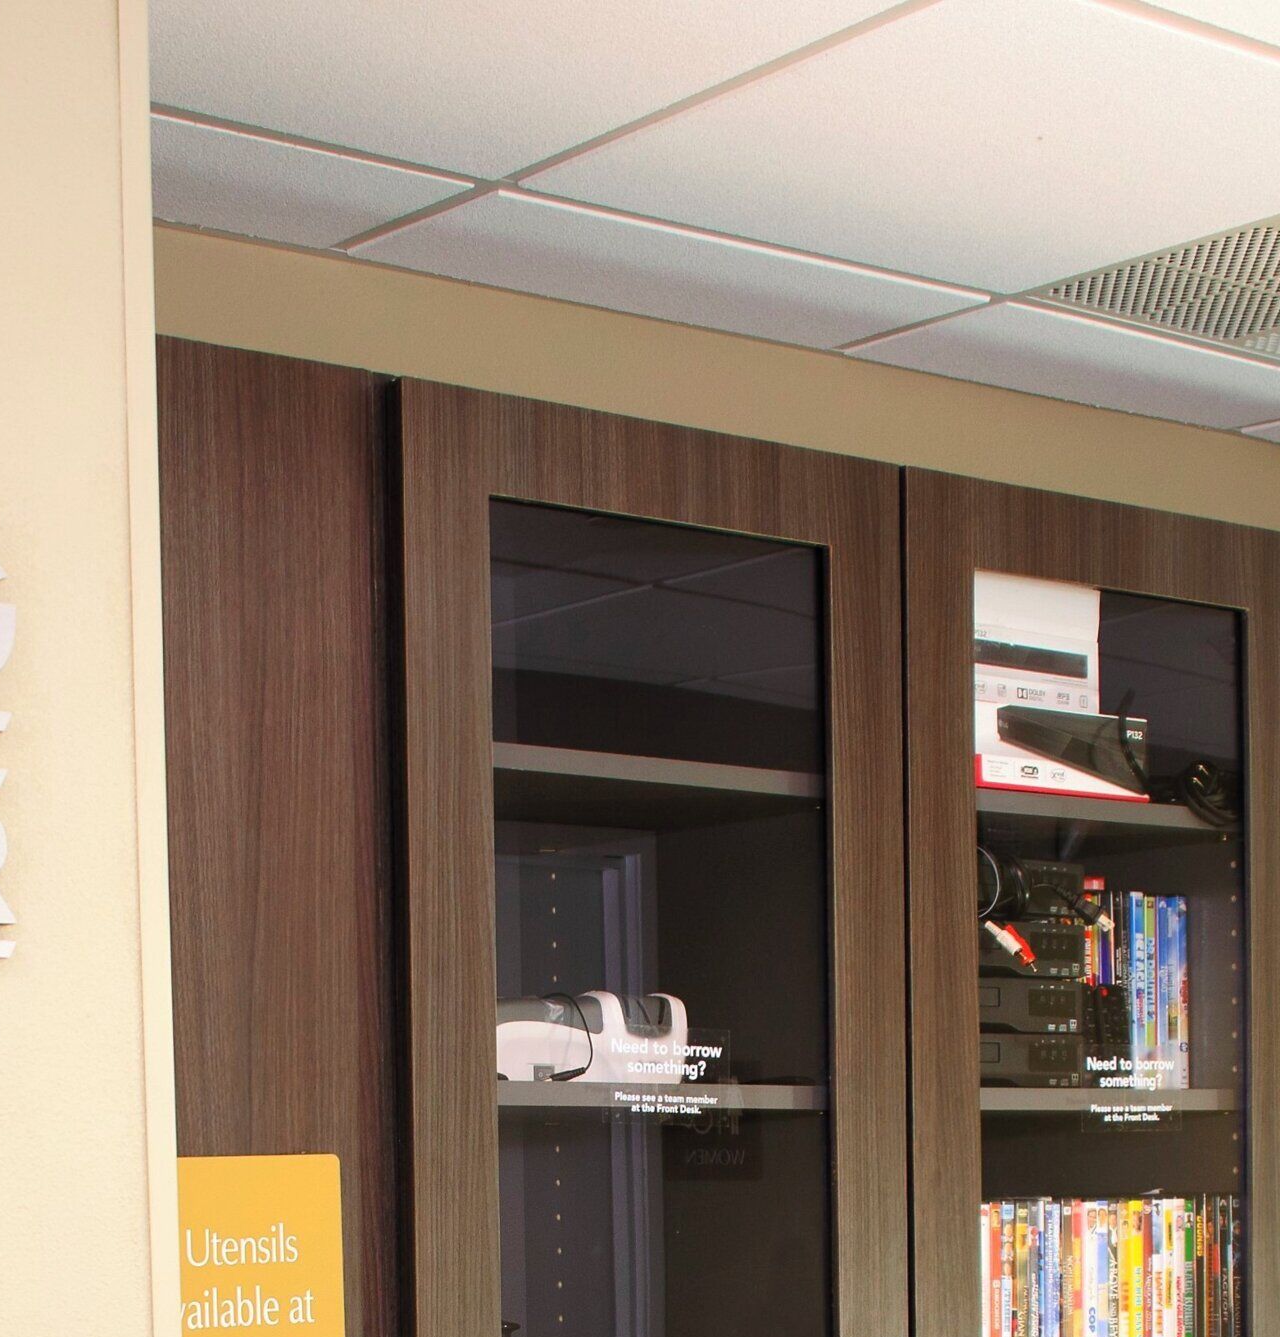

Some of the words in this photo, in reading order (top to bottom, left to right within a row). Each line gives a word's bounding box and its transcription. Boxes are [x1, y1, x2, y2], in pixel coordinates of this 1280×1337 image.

[611, 1038, 648, 1054] Need
[653, 1041, 668, 1055] to
[673, 1040, 722, 1058] borrow
[627, 1060, 706, 1080] something?
[1086, 1056, 1117, 1070] Need
[1119, 1058, 1132, 1070] to
[1136, 1057, 1174, 1070] borrow
[1099, 1073, 1162, 1091] something?
[614, 1091, 640, 1102] Please
[664, 1095, 685, 1103] team
[686, 1095, 718, 1104] member
[631, 1104, 640, 1112] at
[641, 1103, 655, 1113] the
[656, 1104, 678, 1113] Front
[680, 1105, 702, 1114] Desk.
[185, 1222, 299, 1267] Utensils
[1196, 1215, 1205, 1257] GOONIES
[1108, 1259, 1118, 1299] ABOVE
[178, 1285, 280, 1329] ailable
[289, 1287, 315, 1325] at
[1184, 1296, 1194, 1334] KNIGHT
[1088, 1306, 1096, 1334] COP
